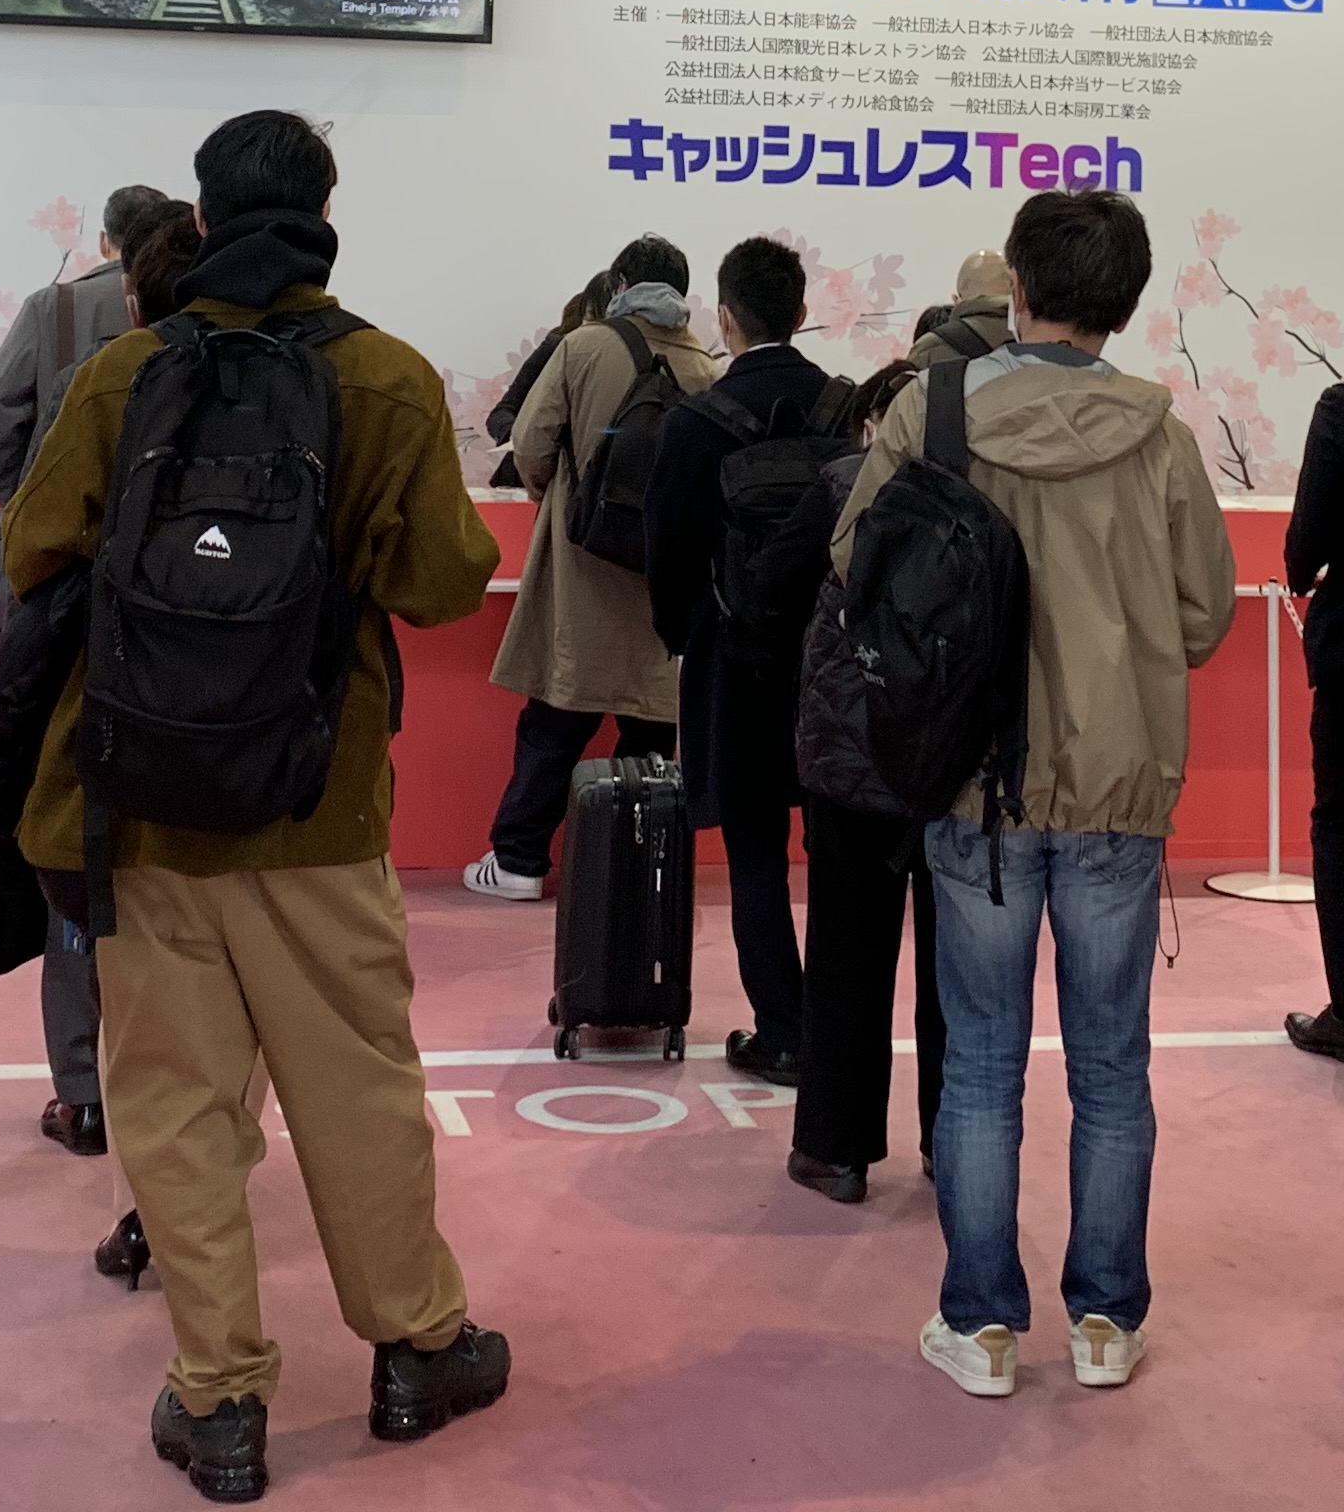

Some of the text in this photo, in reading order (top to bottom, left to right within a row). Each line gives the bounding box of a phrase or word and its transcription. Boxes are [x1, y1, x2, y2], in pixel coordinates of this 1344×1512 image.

[379, 3, 416, 16] Temple
[872, 15, 1075, 40] 一般社団法人日本ホテル協会
[1089, 24, 1274, 48] 一般社団法人日本旅館協会
[665, 33, 1198, 71] 一般社団法人国際観光日本レストラン協会 公益社団法人国際観光施設協会
[664, 60, 1183, 96] 公益社団法人日本給食サービス協会 一般社団法人日本弁当サービス協会
[664, 87, 1152, 121] 公益社団法人日本メディカル給食協会 一般社団法人日本厨房工業会
[423, 1082, 796, 1137] TOP
